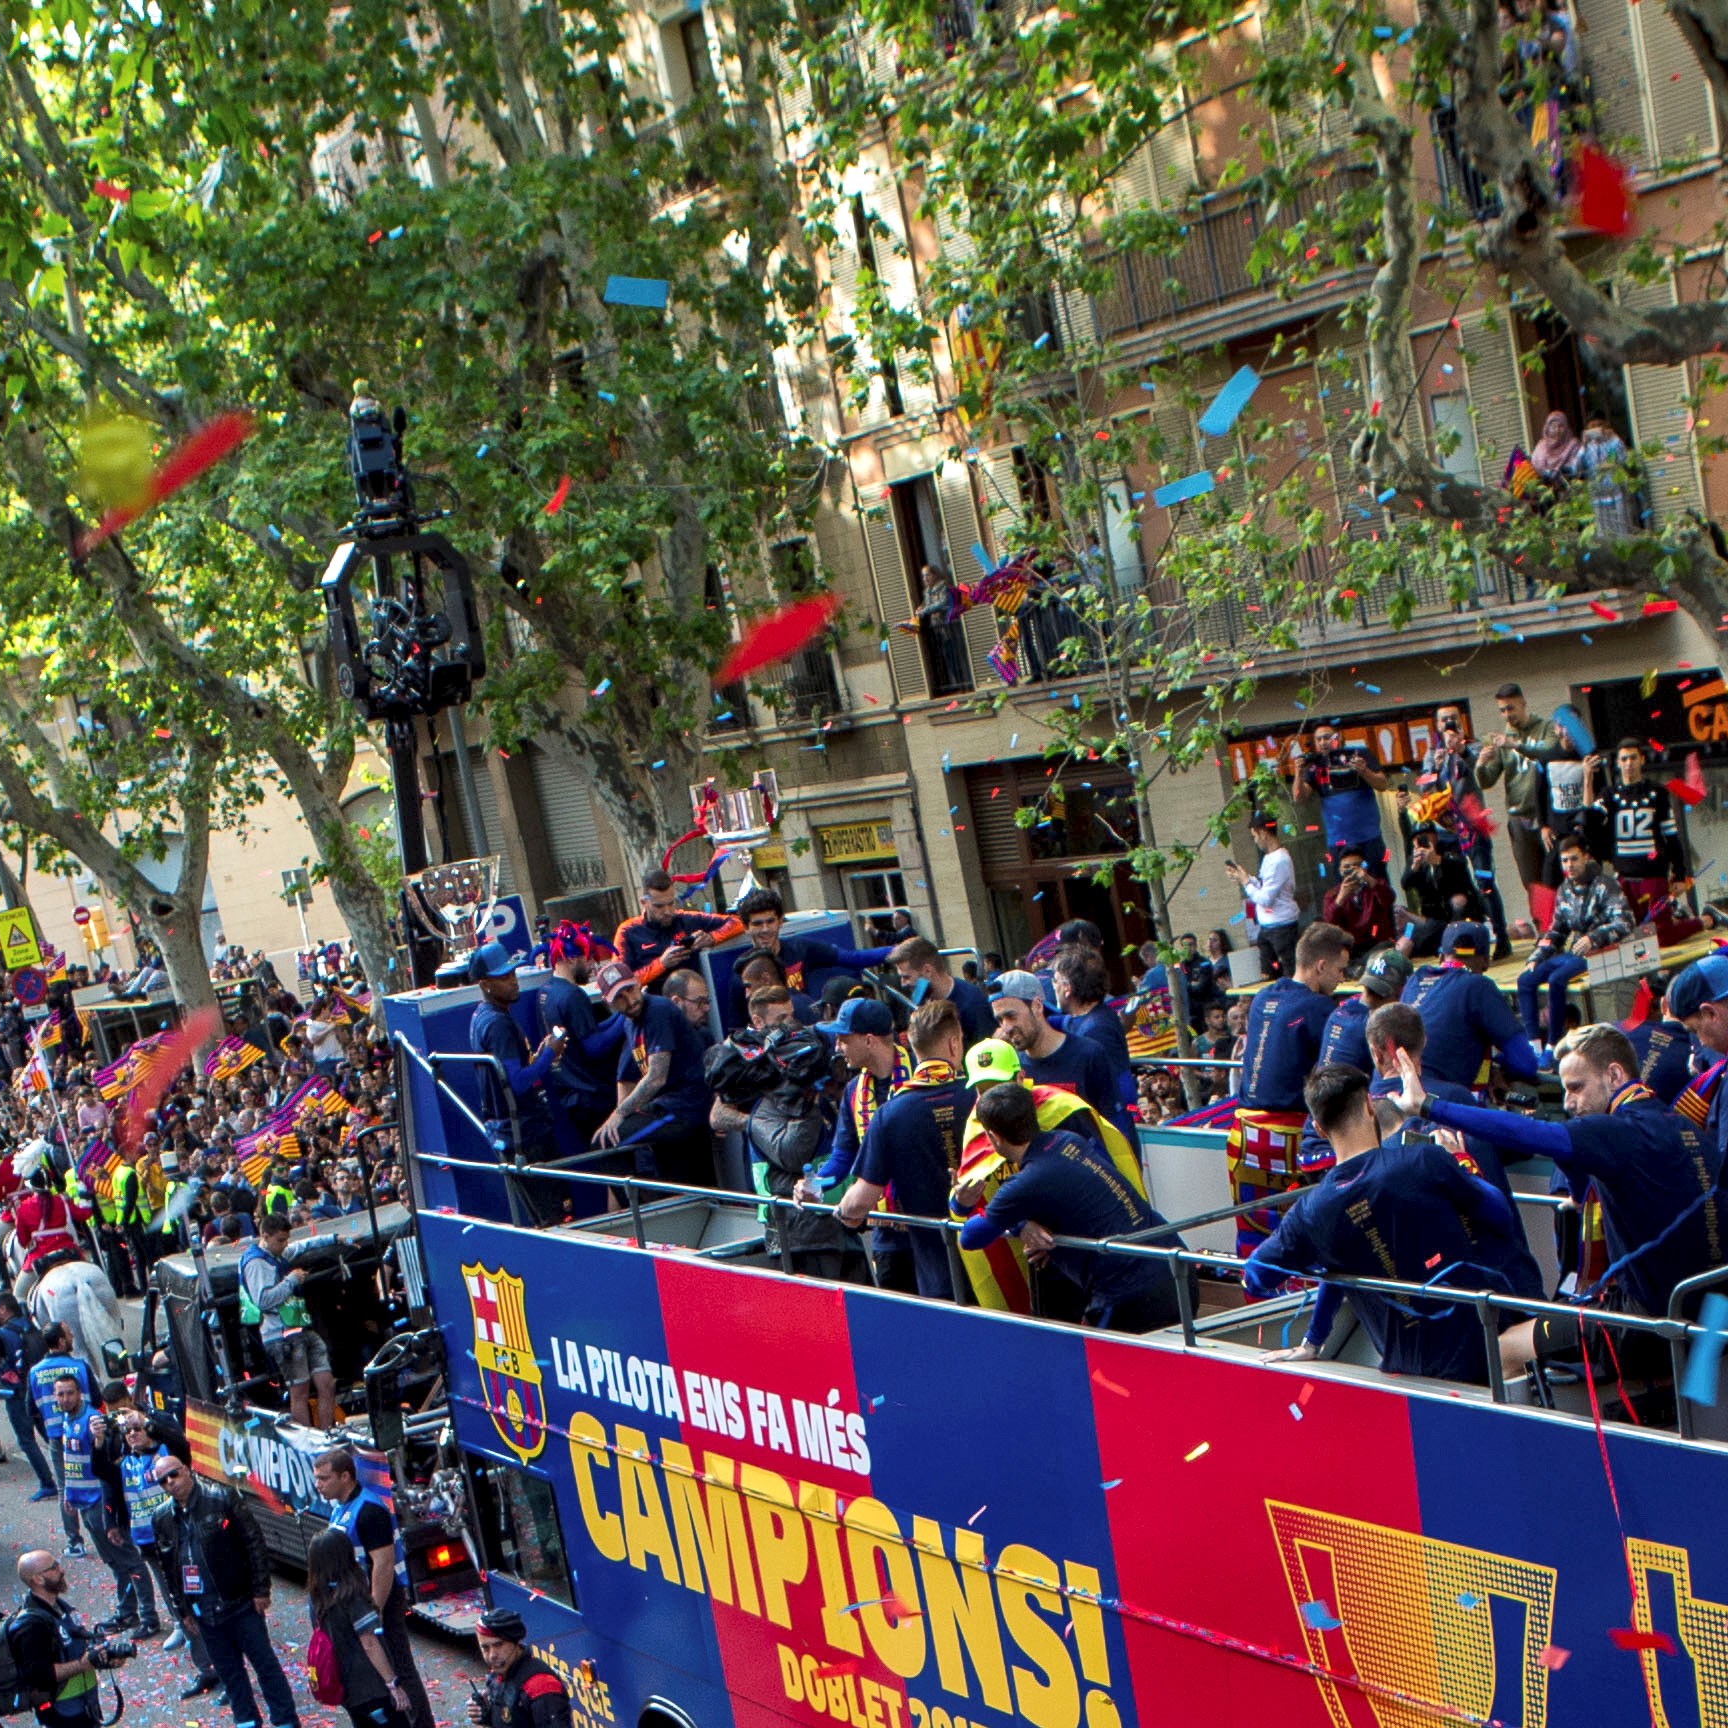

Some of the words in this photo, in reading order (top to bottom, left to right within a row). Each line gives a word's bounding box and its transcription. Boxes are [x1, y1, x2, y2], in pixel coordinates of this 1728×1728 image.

[1617, 808, 1655, 839] 02
[551, 1336, 587, 1395] LA
[585, 1344, 686, 1423] PILOTA
[683, 1370, 747, 1440] ENS
[746, 1387, 793, 1455] FA
[791, 1388, 872, 1476] MÉS
